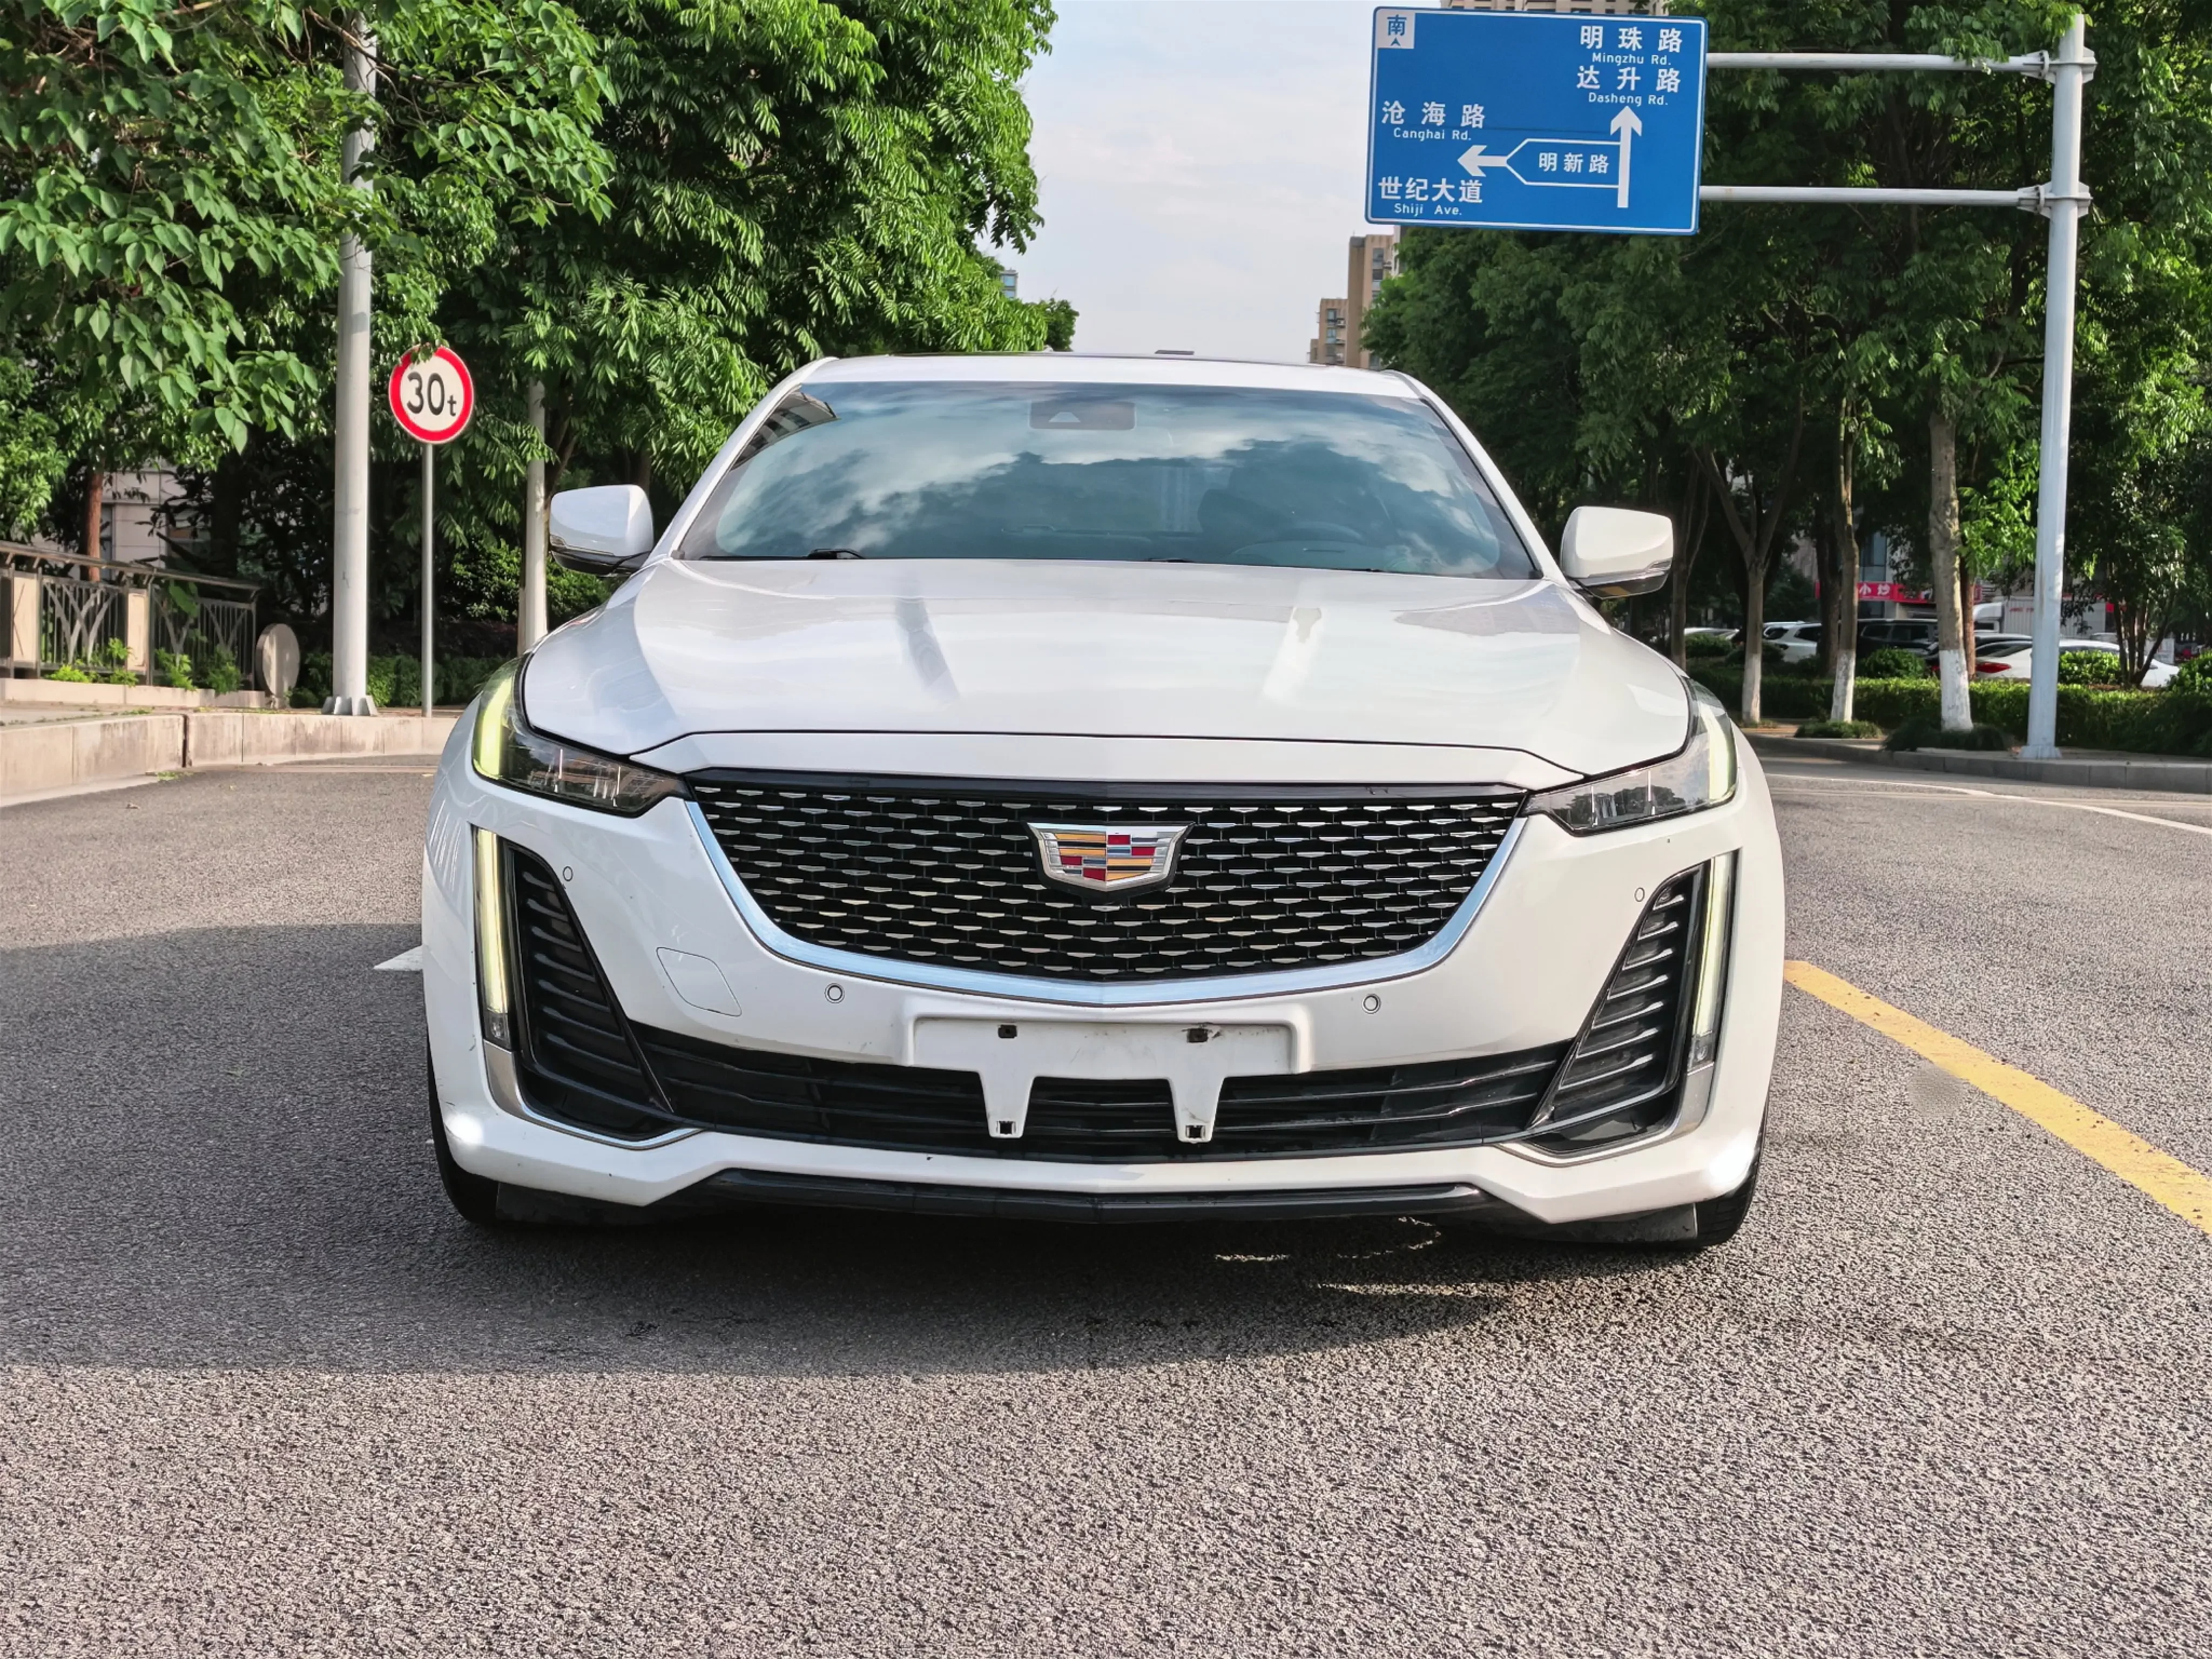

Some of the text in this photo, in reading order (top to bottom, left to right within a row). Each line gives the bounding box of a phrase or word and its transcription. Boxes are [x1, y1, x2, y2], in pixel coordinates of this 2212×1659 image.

[1387, 15, 1406, 36] 南
[1581, 25, 1682, 53] 明珠路
[1591, 53, 1671, 66] Mingzhu Rd.
[1576, 66, 1681, 93] 达升路
[1588, 92, 1668, 106] Dasheng Rd.
[1382, 100, 1485, 129] 沧海路
[1393, 127, 1472, 140] Canghai Rd.
[1539, 152, 1609, 173] 明新路
[1378, 177, 1483, 203] 世纪大道
[1394, 203, 1462, 216] Shiji Ave.
[407, 371, 457, 417] 30t
